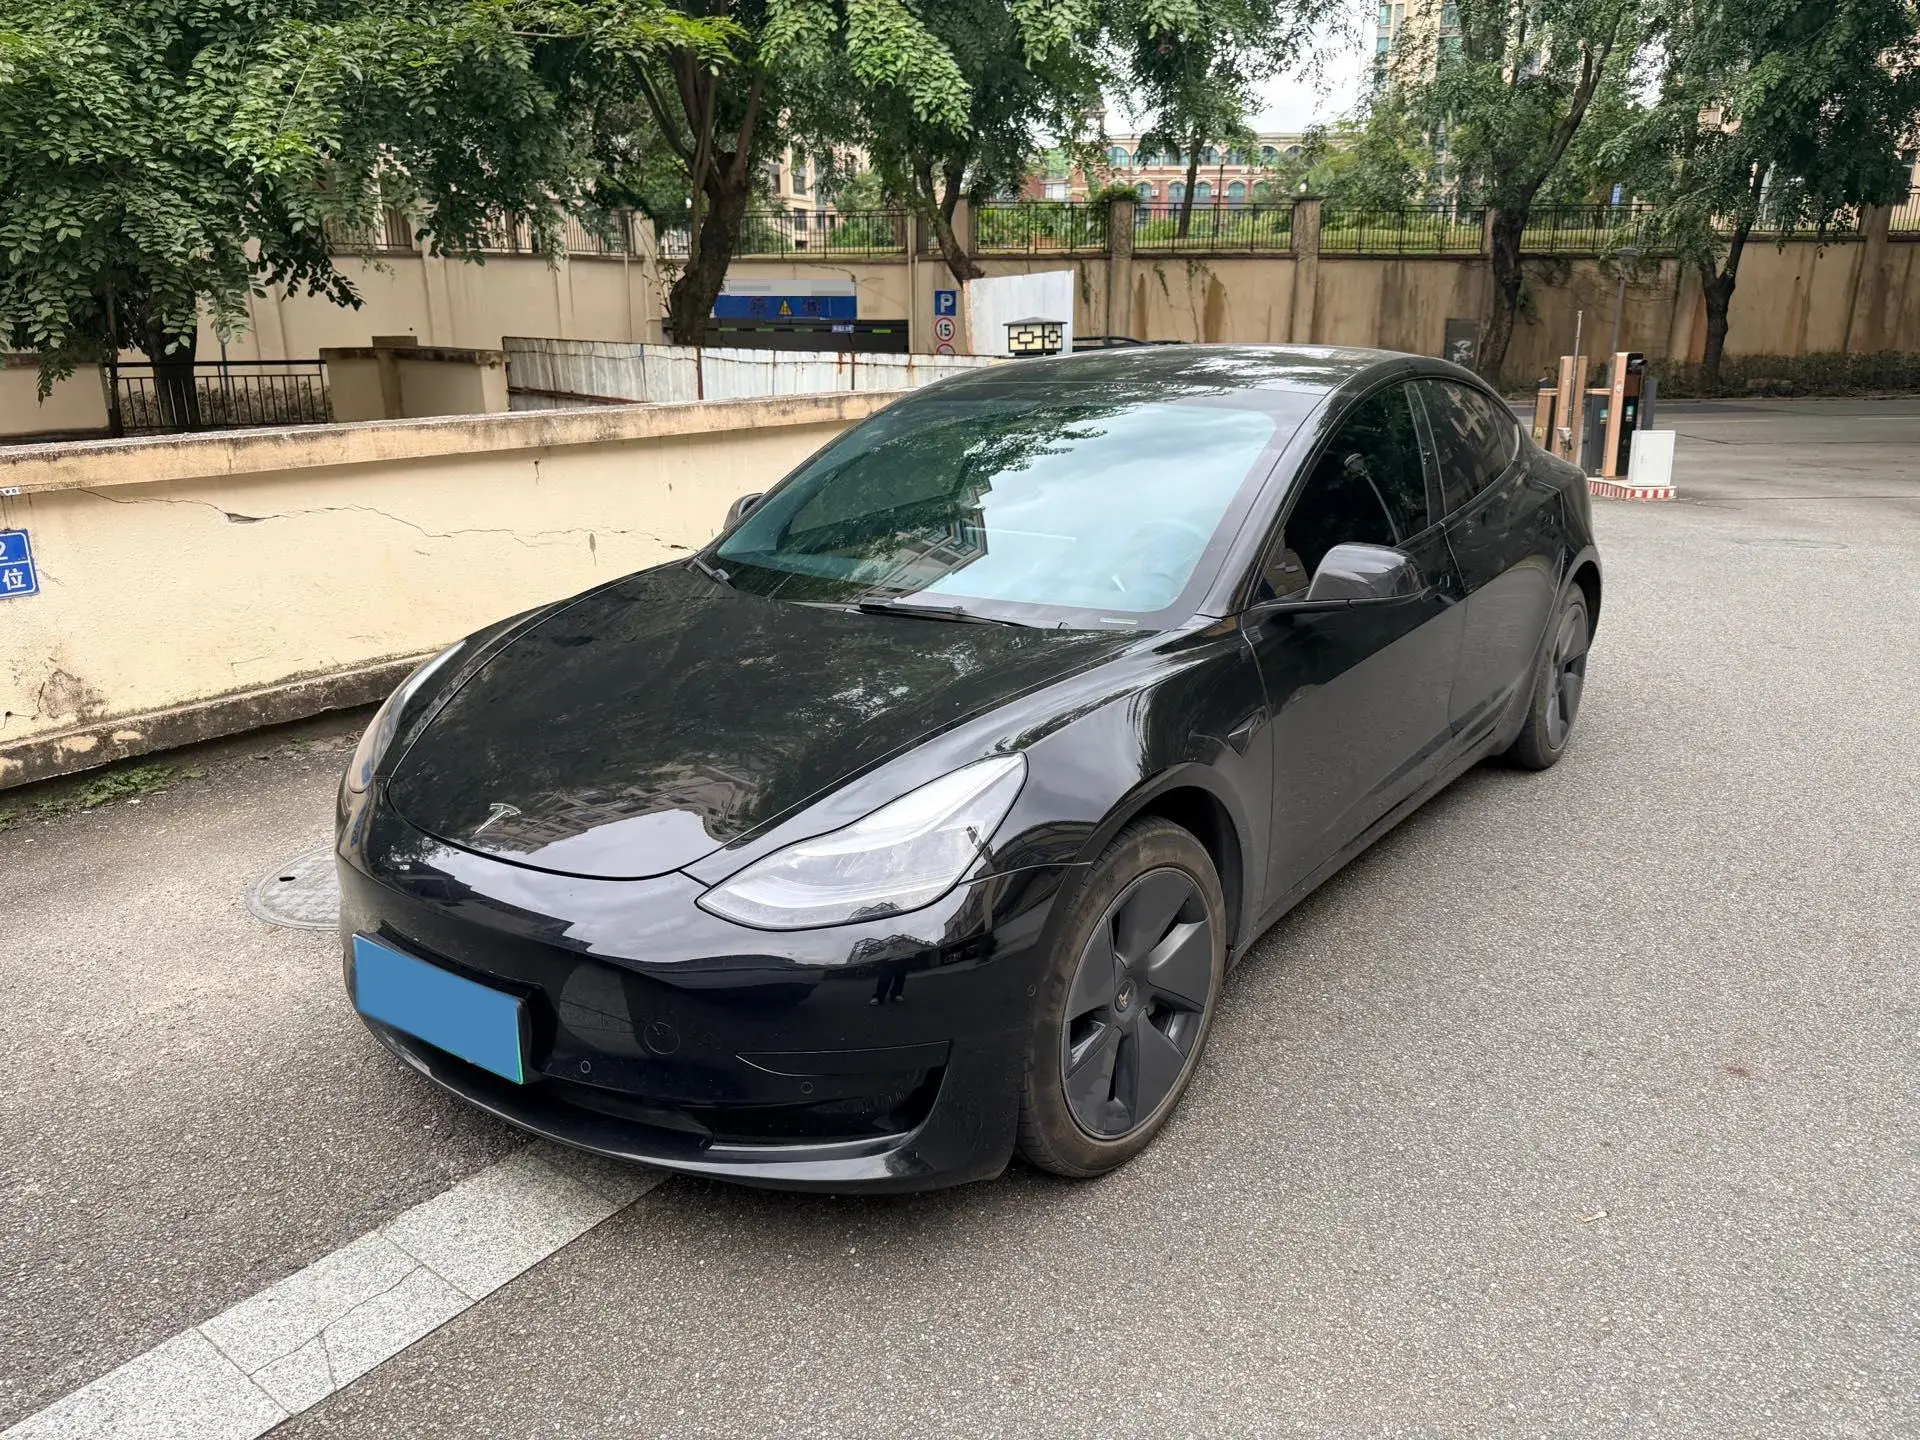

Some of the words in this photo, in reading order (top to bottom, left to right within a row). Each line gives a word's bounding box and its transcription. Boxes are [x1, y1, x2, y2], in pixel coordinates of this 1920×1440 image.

[940, 293, 953, 313] P
[939, 323, 951, 337] 15
[2, 568, 26, 591] 位
